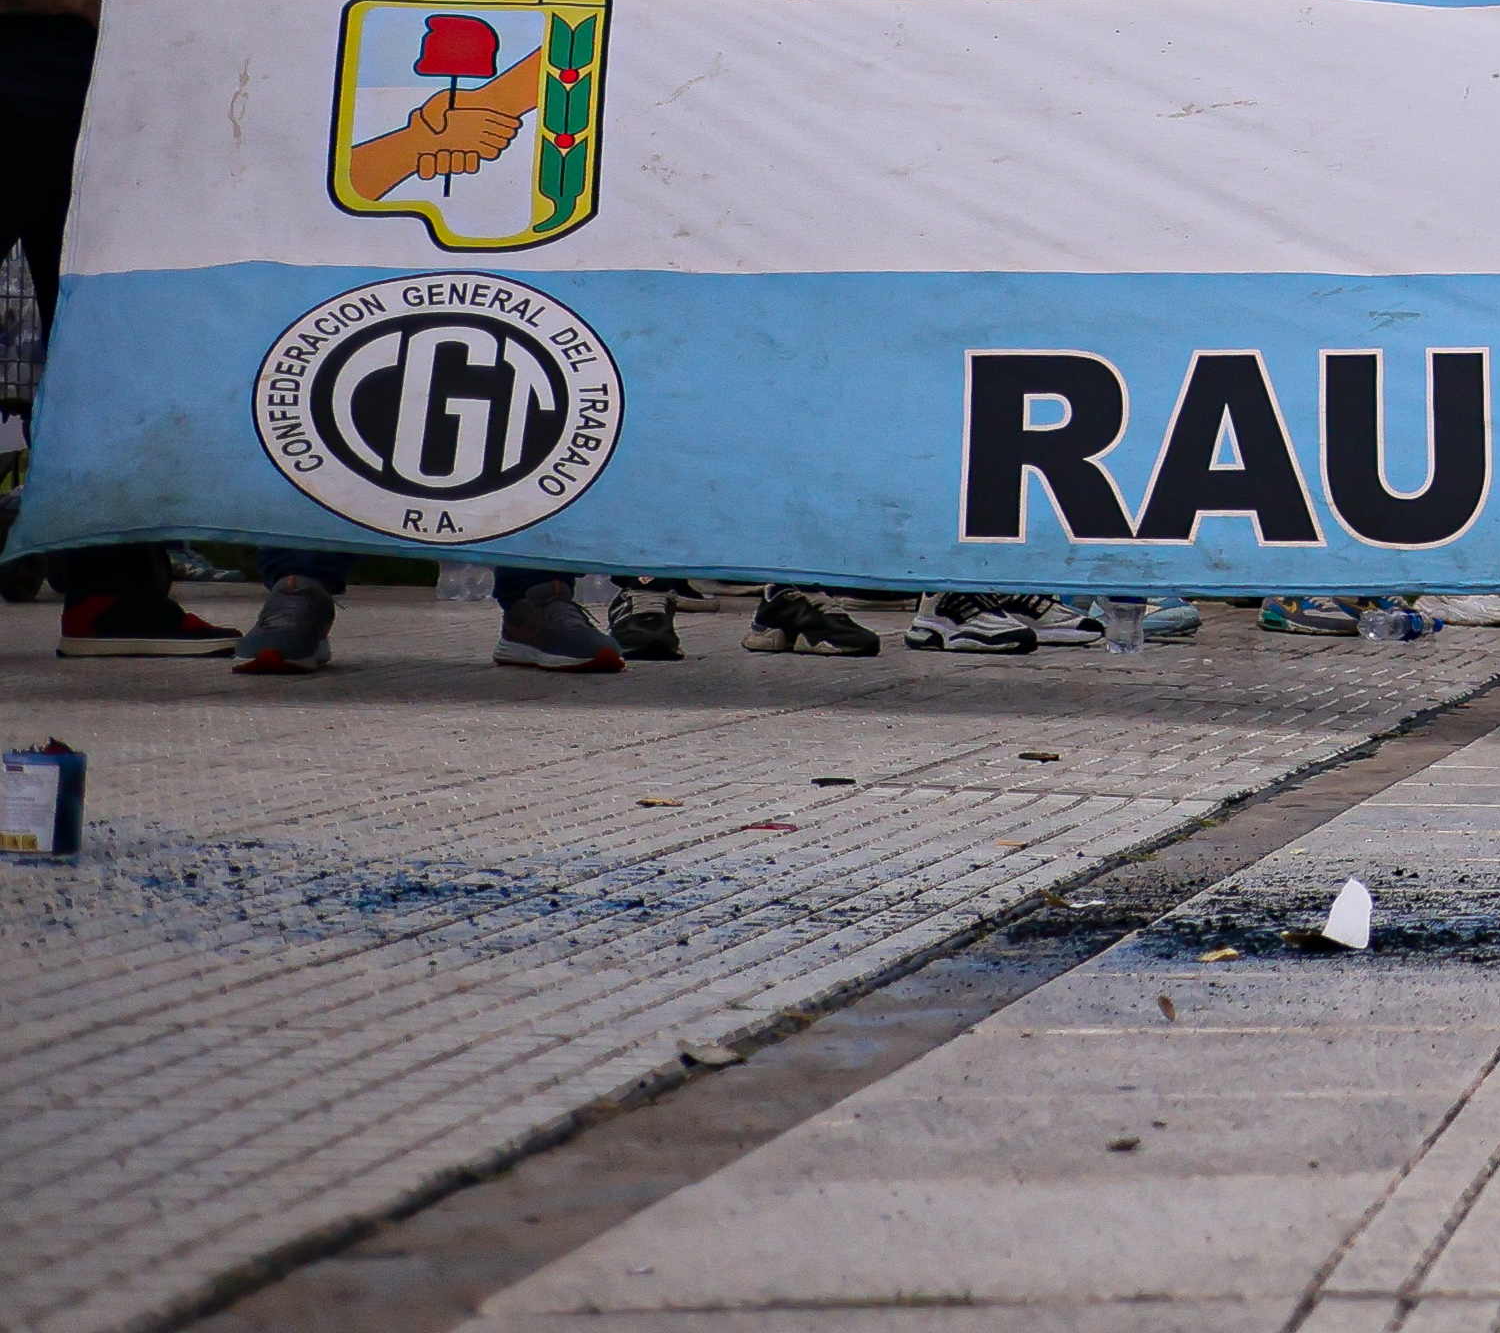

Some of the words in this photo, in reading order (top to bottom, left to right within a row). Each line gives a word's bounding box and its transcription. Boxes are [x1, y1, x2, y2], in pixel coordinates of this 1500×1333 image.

[402, 283, 548, 329] GENERAL
[268, 293, 387, 473] CONFEDERACION
[549, 327, 597, 373] DEL
[332, 325, 556, 488] CGT
[538, 382, 610, 498] TRABAJO
[402, 509, 428, 533] R.
[436, 510, 464, 534] A.
